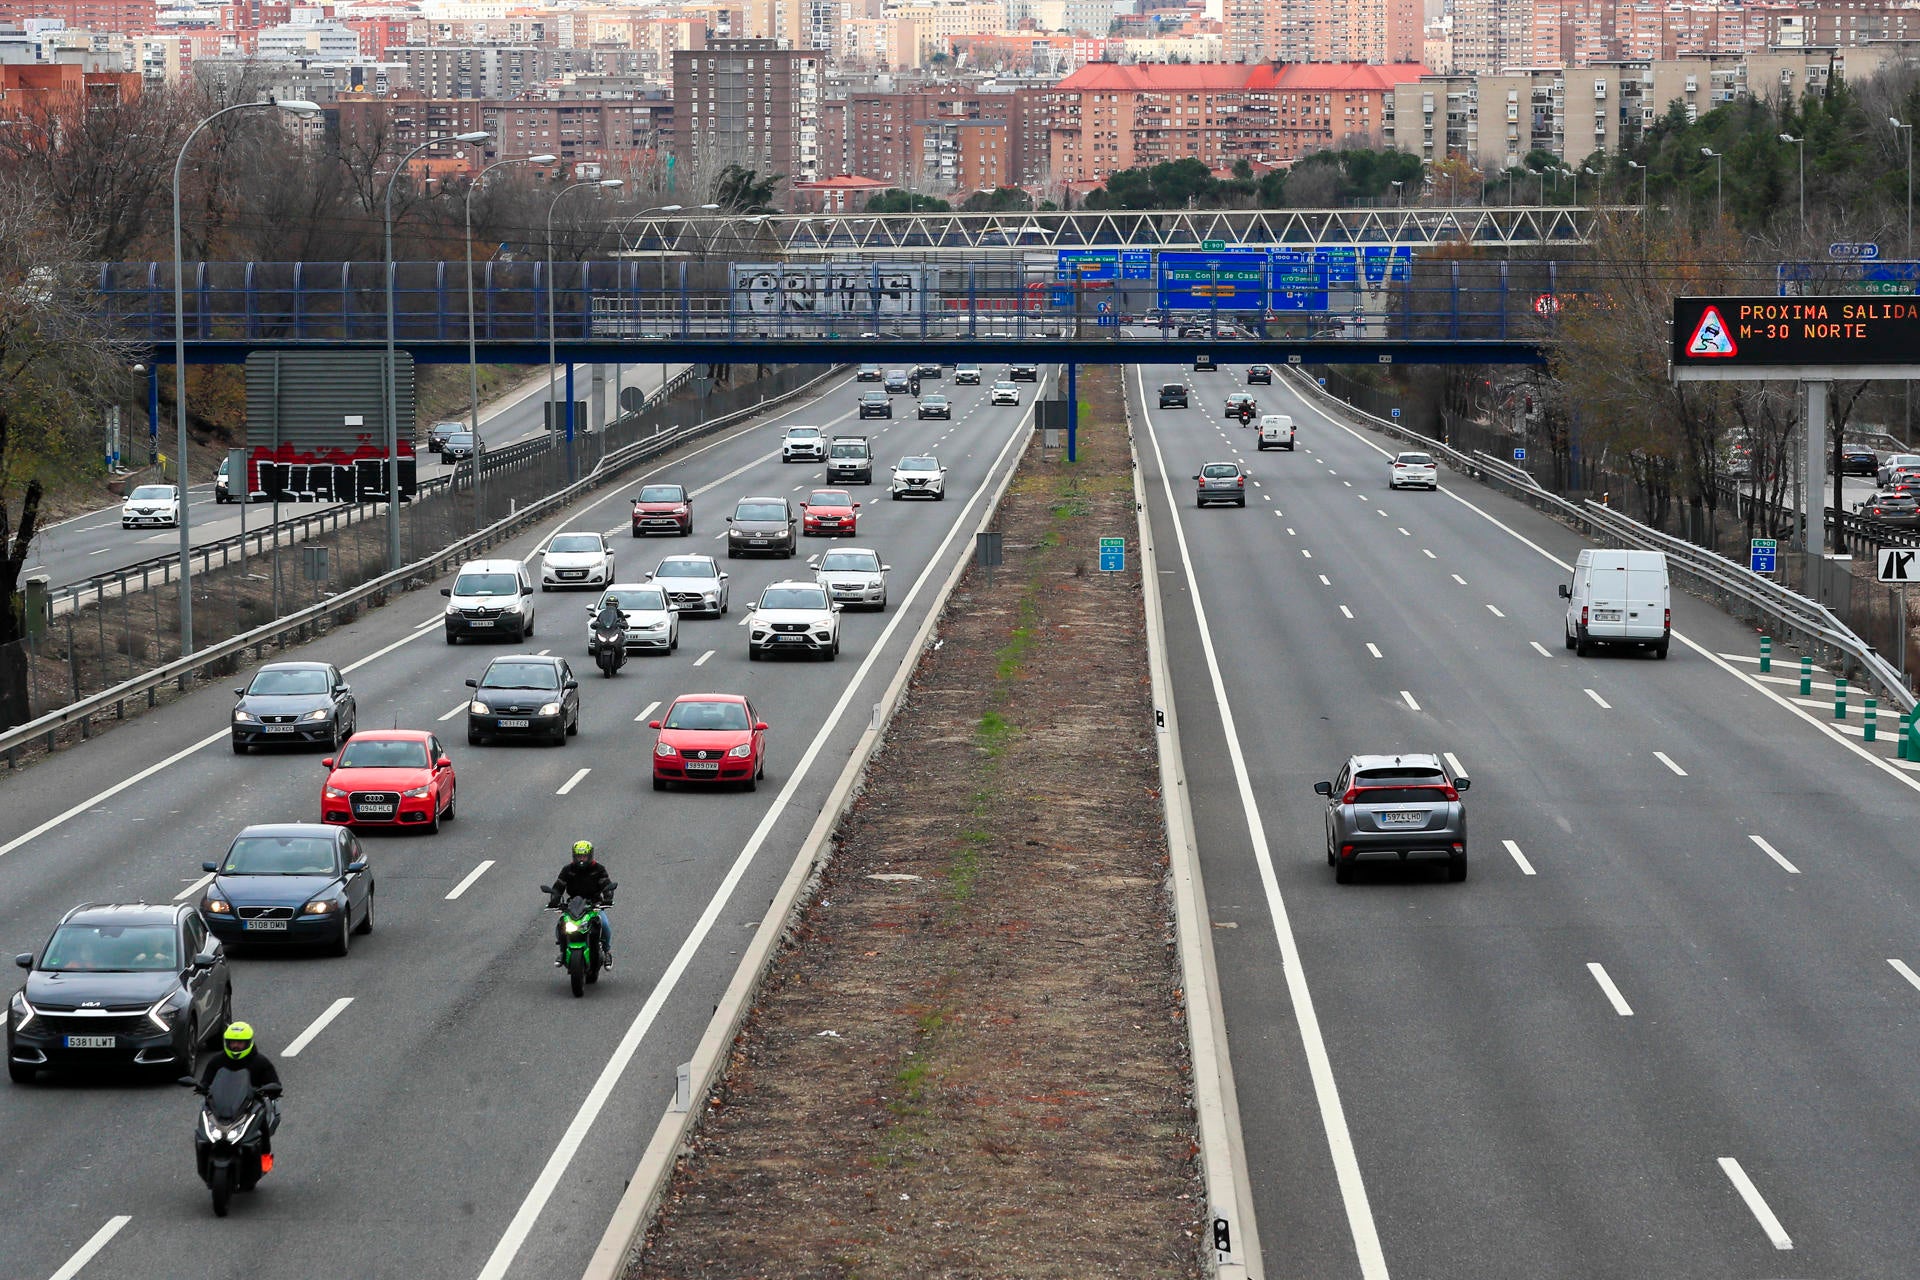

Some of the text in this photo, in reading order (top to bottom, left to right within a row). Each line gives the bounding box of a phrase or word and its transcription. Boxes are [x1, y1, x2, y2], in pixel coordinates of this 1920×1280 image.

[1175, 272, 1192, 280] pza.
[1224, 271, 1234, 279] de
[1740, 304, 1918, 320] PROXIMA SALIDA
[1740, 323, 1867, 339] M-30 NORTE
[1108, 561, 1115, 569] 5
[1760, 562, 1767, 570] 5
[249, 921, 268, 929] 5108
[70, 1038, 113, 1046] 5381 LWT
